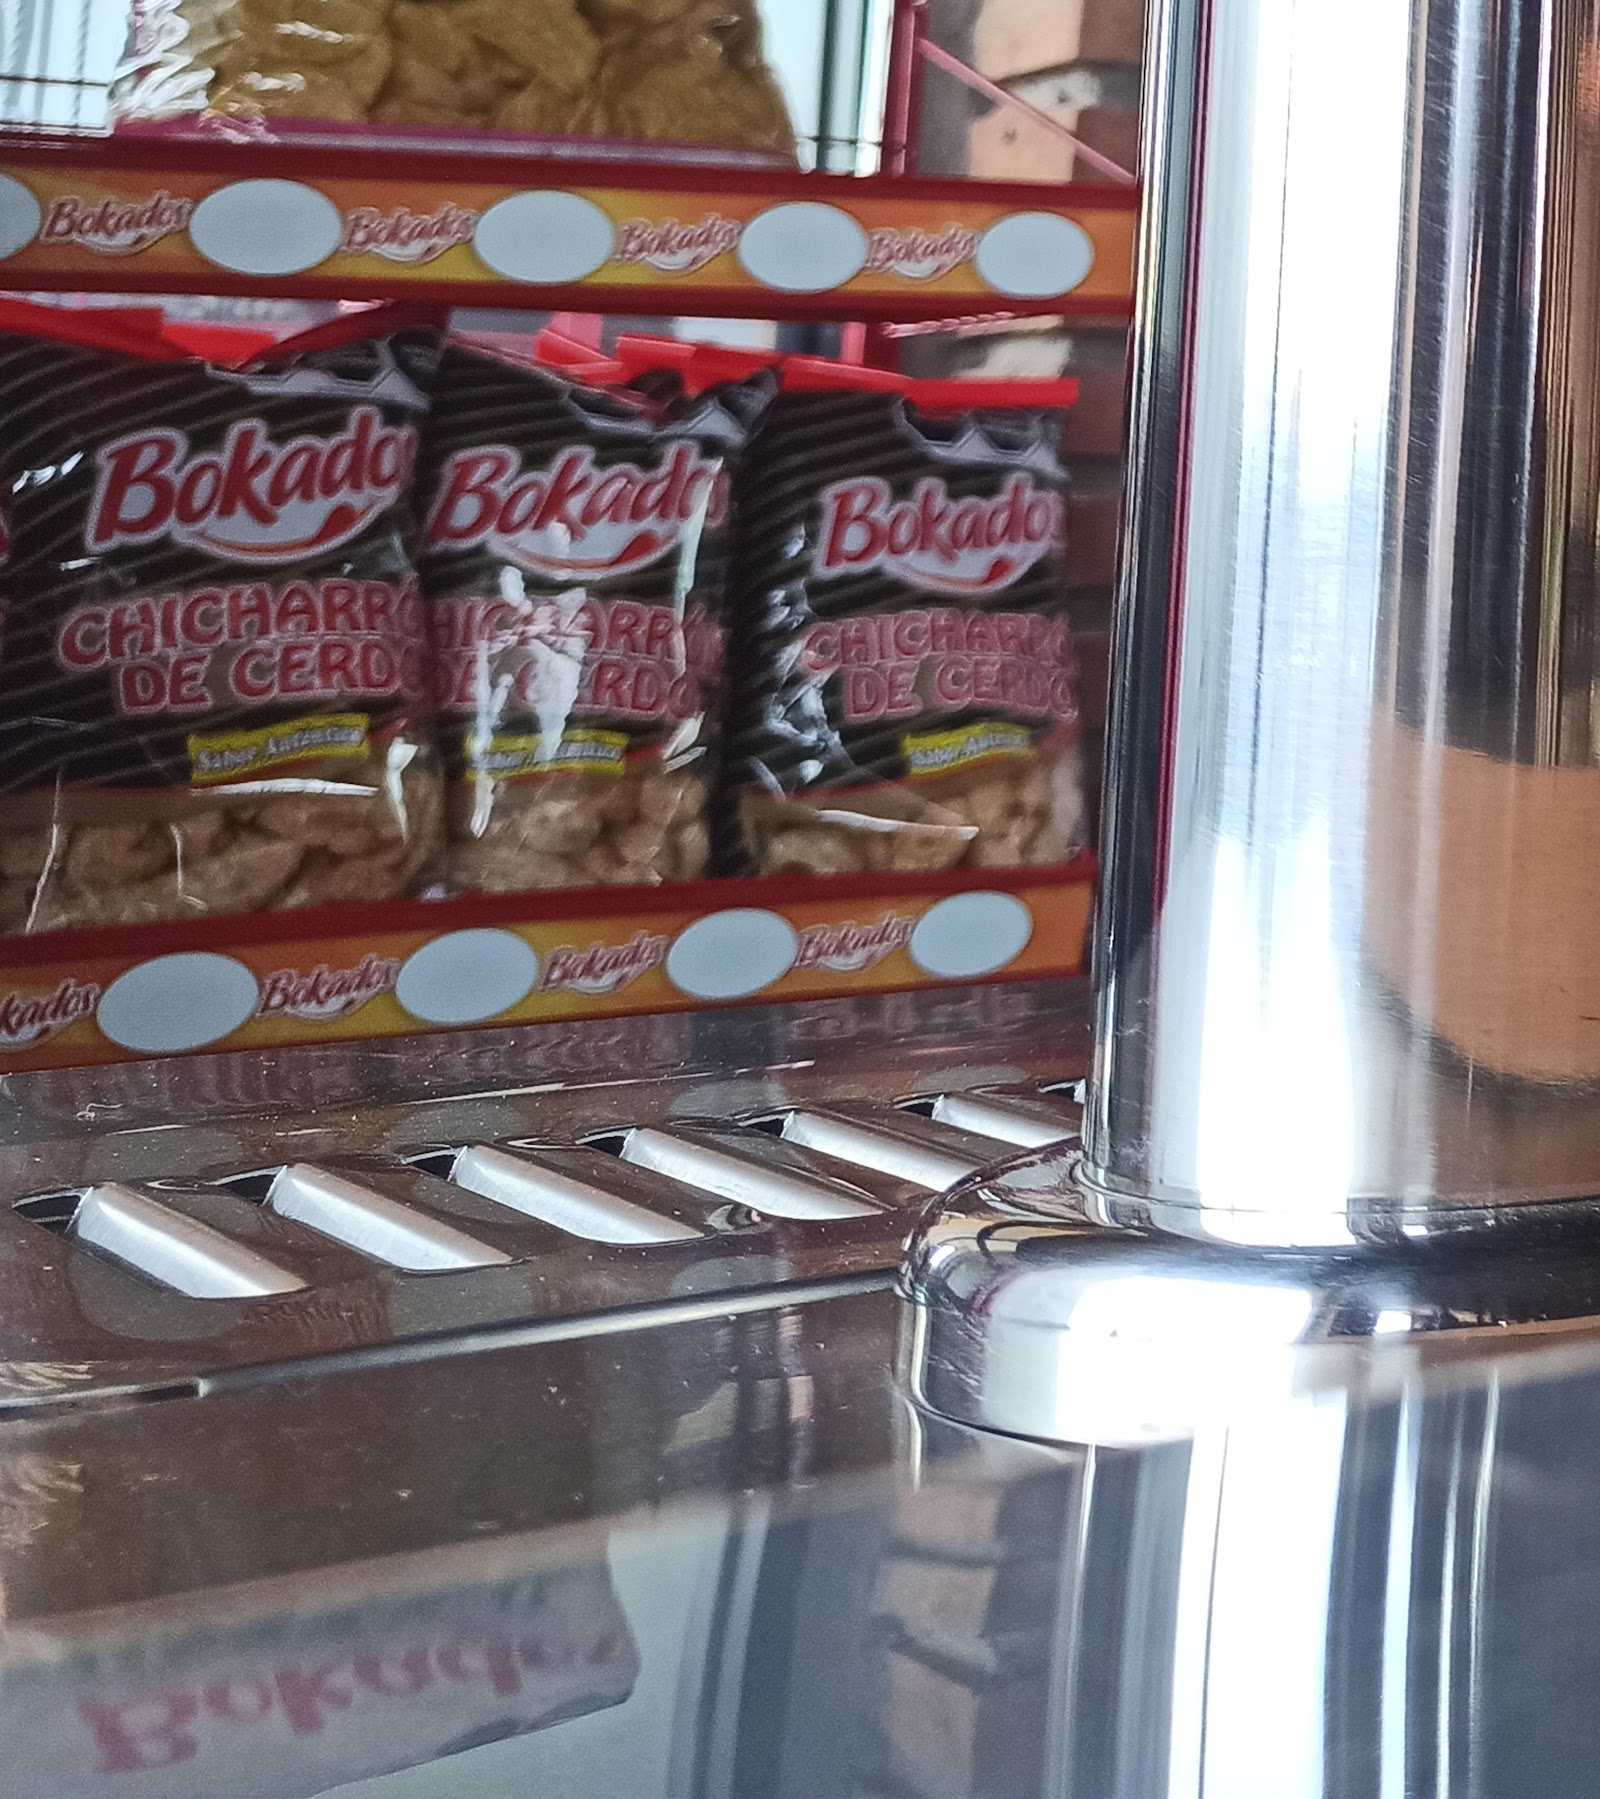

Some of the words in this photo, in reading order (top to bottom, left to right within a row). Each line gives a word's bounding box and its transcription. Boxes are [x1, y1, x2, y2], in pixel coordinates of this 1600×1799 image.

[44, 191, 192, 243] Bokados
[343, 204, 479, 252] Bokados
[428, 444, 729, 542] Bokado
[820, 478, 1064, 570] Bokado
[121, 656, 208, 710] DE
[846, 663, 922, 718] DE
[0, 978, 99, 1036] kados
[259, 954, 400, 1015] Bokados
